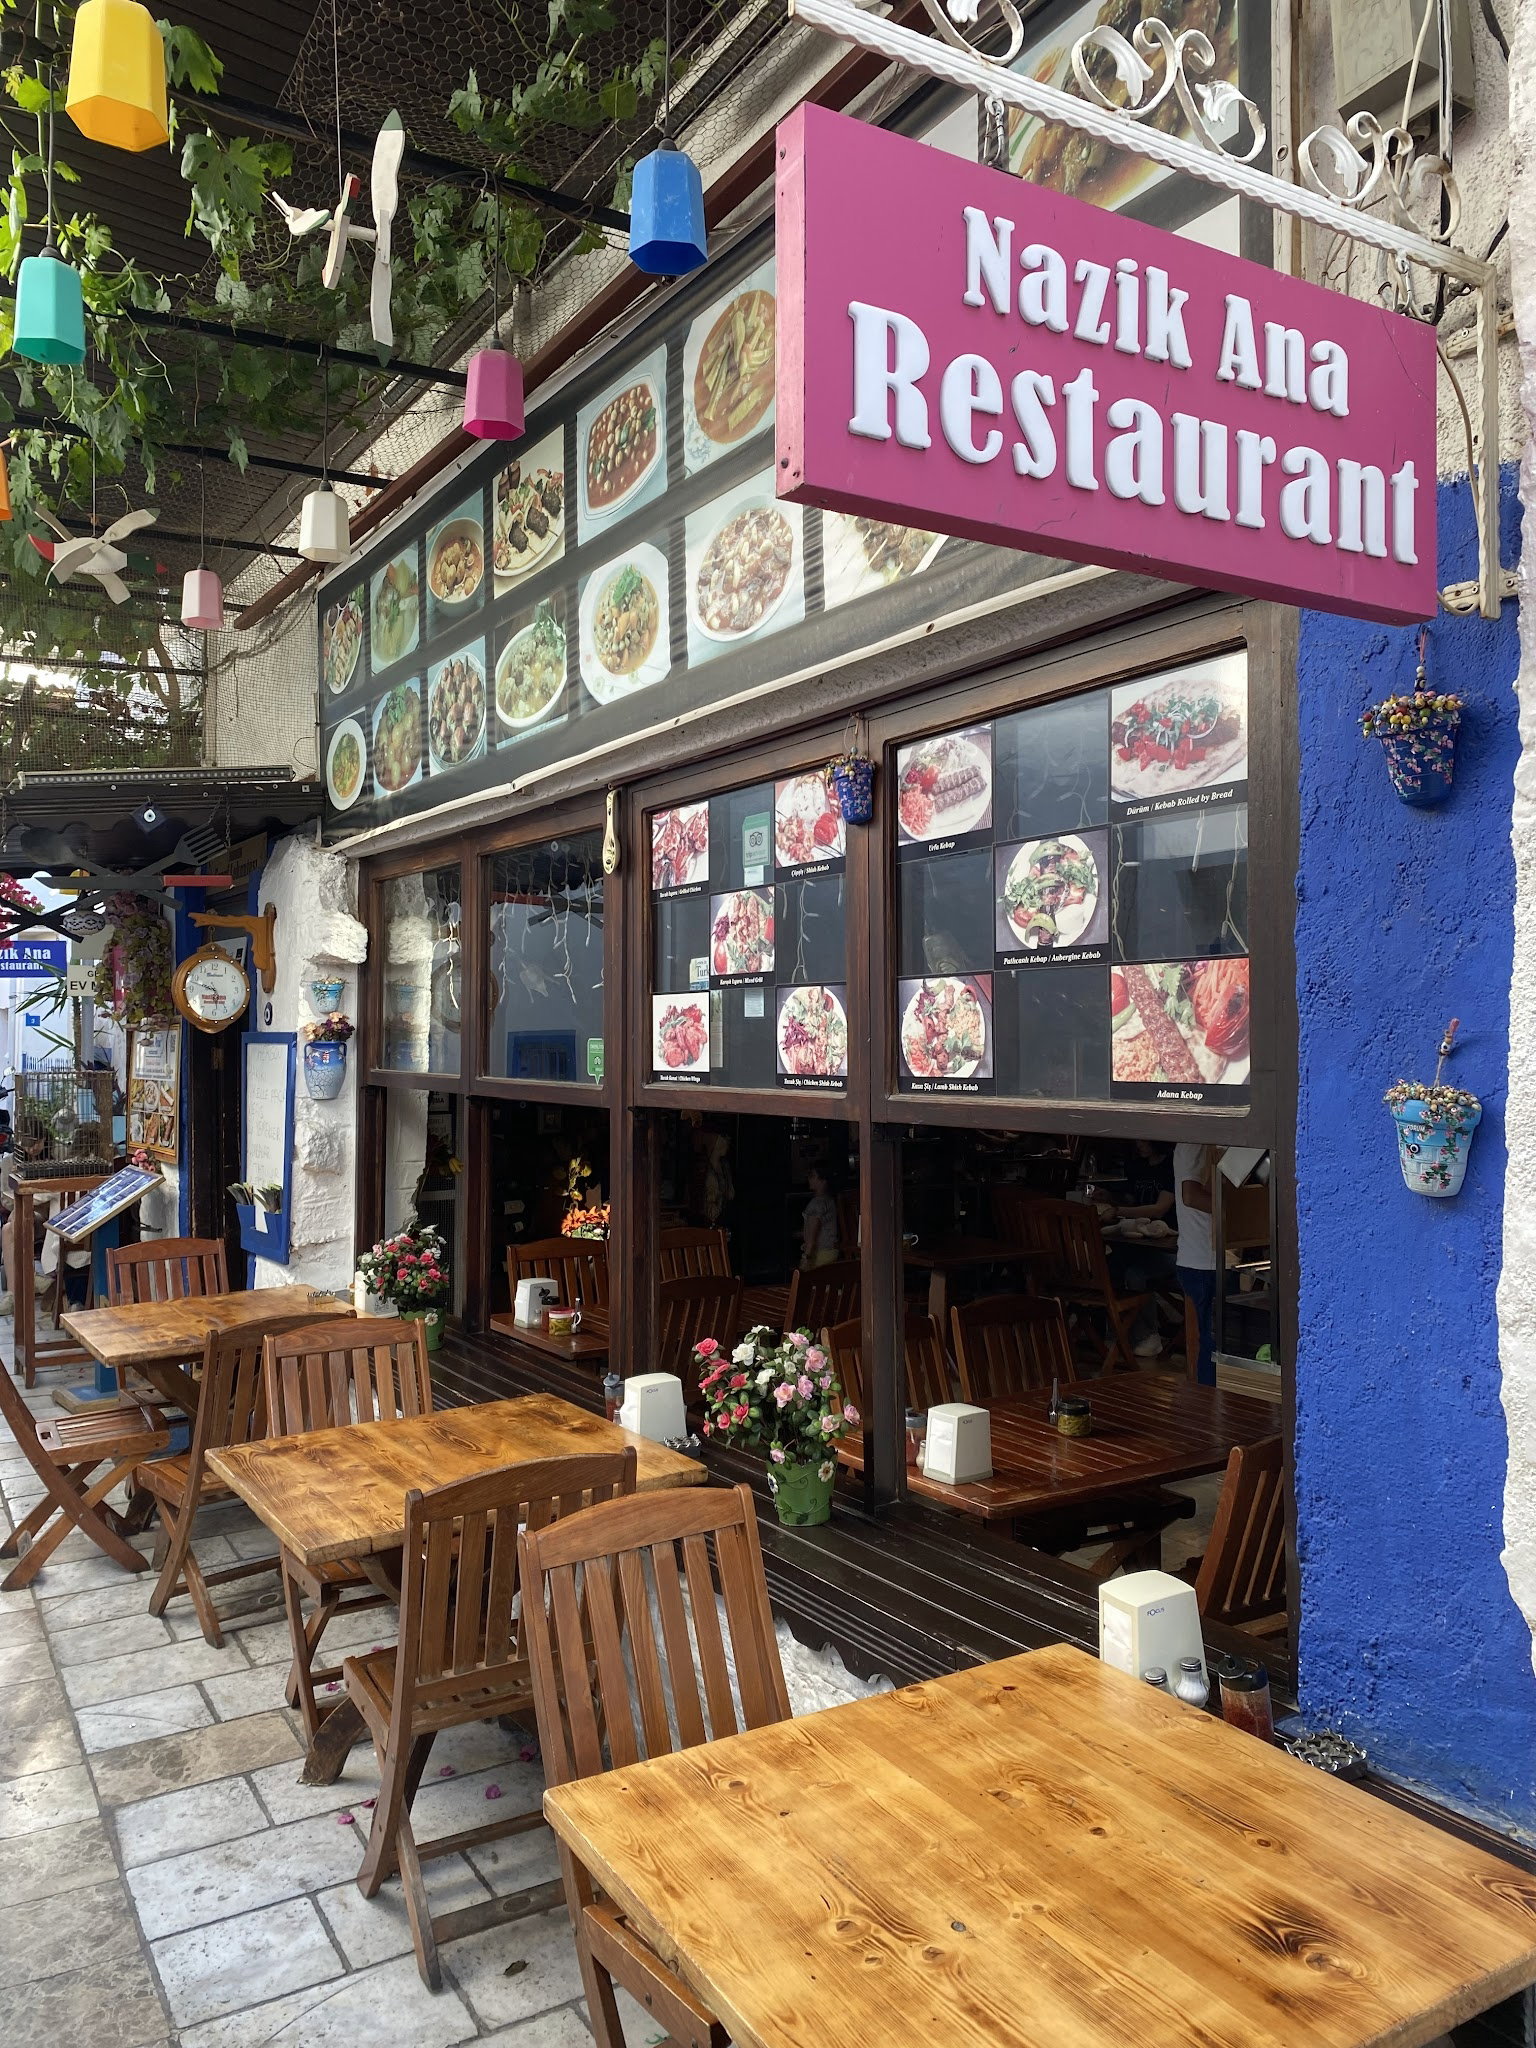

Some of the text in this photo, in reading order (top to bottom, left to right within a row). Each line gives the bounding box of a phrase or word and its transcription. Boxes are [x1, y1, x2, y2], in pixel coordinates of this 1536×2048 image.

[962, 206, 1351, 417] Nazik Ana
[847, 301, 1420, 566] Restaurant
[1154, 799, 1176, 811] Kebab
[1177, 795, 1200, 807] Rolled
[1200, 793, 1210, 804] by
[1210, 789, 1234, 801] Bread
[23, 947, 51, 960] Ana
[1029, 955, 1048, 964] Kebap
[1051, 952, 1081, 963] Aubergine
[1081, 951, 1101, 960] Kebab
[70, 981, 87, 991] EV
[934, 1083, 948, 1091] Lamb
[948, 1083, 962, 1091] Shish
[1157, 1090, 1203, 1101] Adana Kebap
